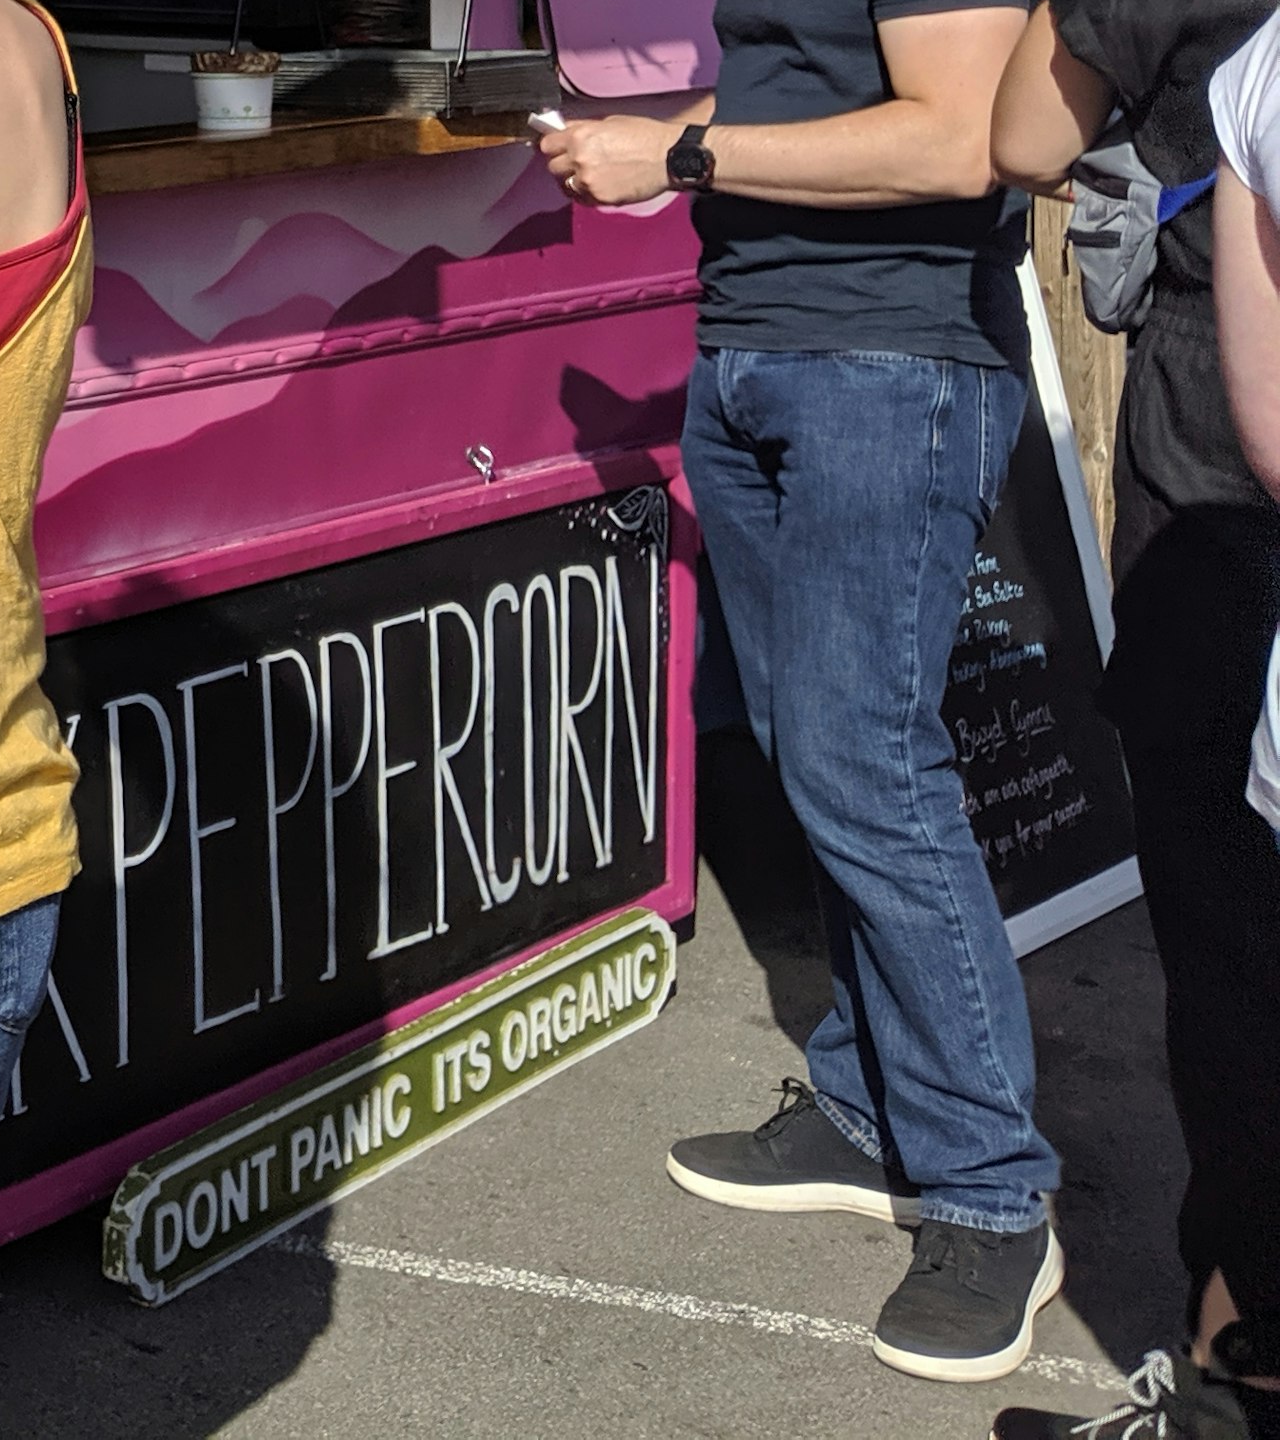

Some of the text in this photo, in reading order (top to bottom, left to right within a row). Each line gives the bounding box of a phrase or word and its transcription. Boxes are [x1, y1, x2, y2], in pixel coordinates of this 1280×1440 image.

[104, 546, 667, 1068] PEPPERCORN
[152, 943, 657, 1270] DONT PANIC ITS ORGANIC
